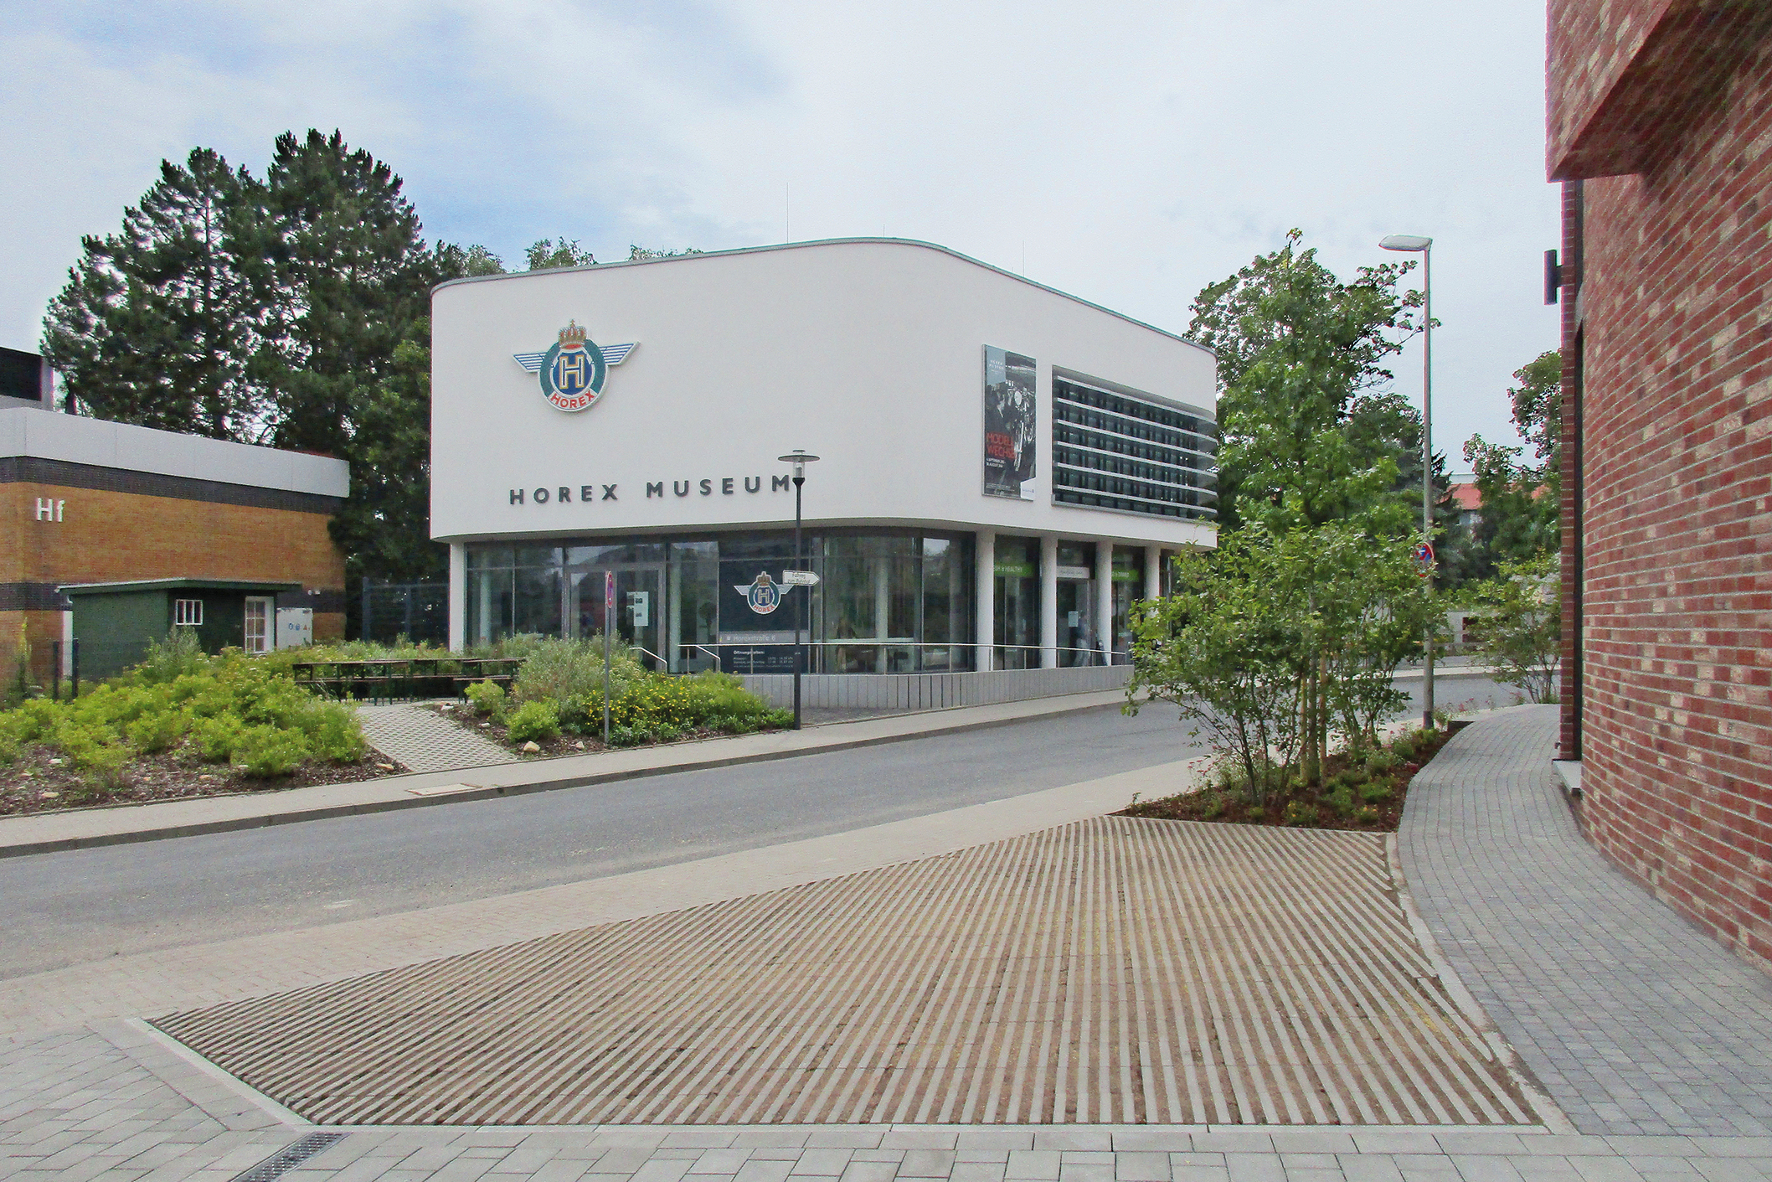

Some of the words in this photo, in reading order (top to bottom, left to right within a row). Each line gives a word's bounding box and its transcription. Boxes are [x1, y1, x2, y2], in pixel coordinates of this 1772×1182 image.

[559, 354, 585, 390] H
[550, 391, 595, 409] HOREX
[509, 484, 618, 505] HOREX
[646, 474, 790, 499] MUSEUM
[35, 497, 66, 523] Hf
[753, 604, 775, 612] HOREX
